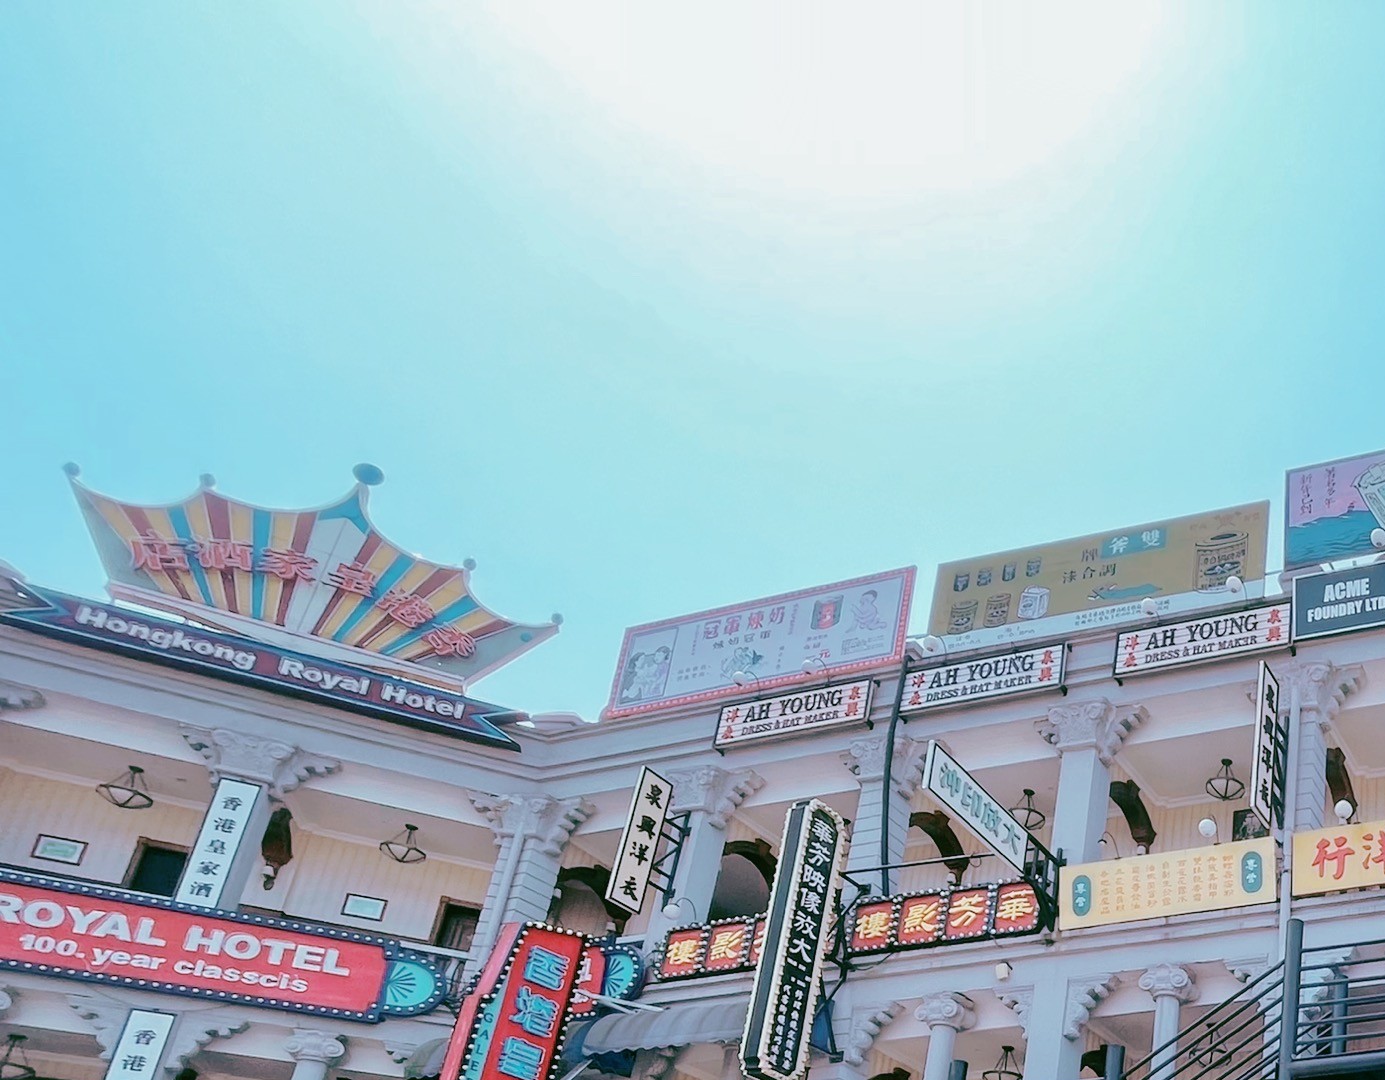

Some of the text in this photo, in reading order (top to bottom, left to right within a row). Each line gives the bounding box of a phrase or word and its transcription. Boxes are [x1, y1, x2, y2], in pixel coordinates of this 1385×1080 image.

[1323, 576, 1370, 600] ACME
[1307, 599, 1363, 623] FOUNDRY
[1144, 628, 1176, 651] AH
[1186, 613, 1258, 641] YOUNG
[75, 604, 465, 720] Hongkong Royal Hotel
[1144, 649, 1180, 664] DRESS
[1191, 643, 1214, 656] HAT
[928, 654, 1035, 689] AH YOUNG
[743, 689, 843, 723] AH YOUNG
[926, 687, 959, 702] DRESS
[968, 681, 992, 695] HAT
[741, 722, 773, 736] DRESS
[781, 716, 803, 729] HAT
[857, 888, 1035, 943] 華芳影樓
[0, 893, 350, 976] ROYAL HOTEL
[666, 927, 767, 966] 影樓
[93, 946, 166, 971] year
[174, 961, 309, 992] classcis
